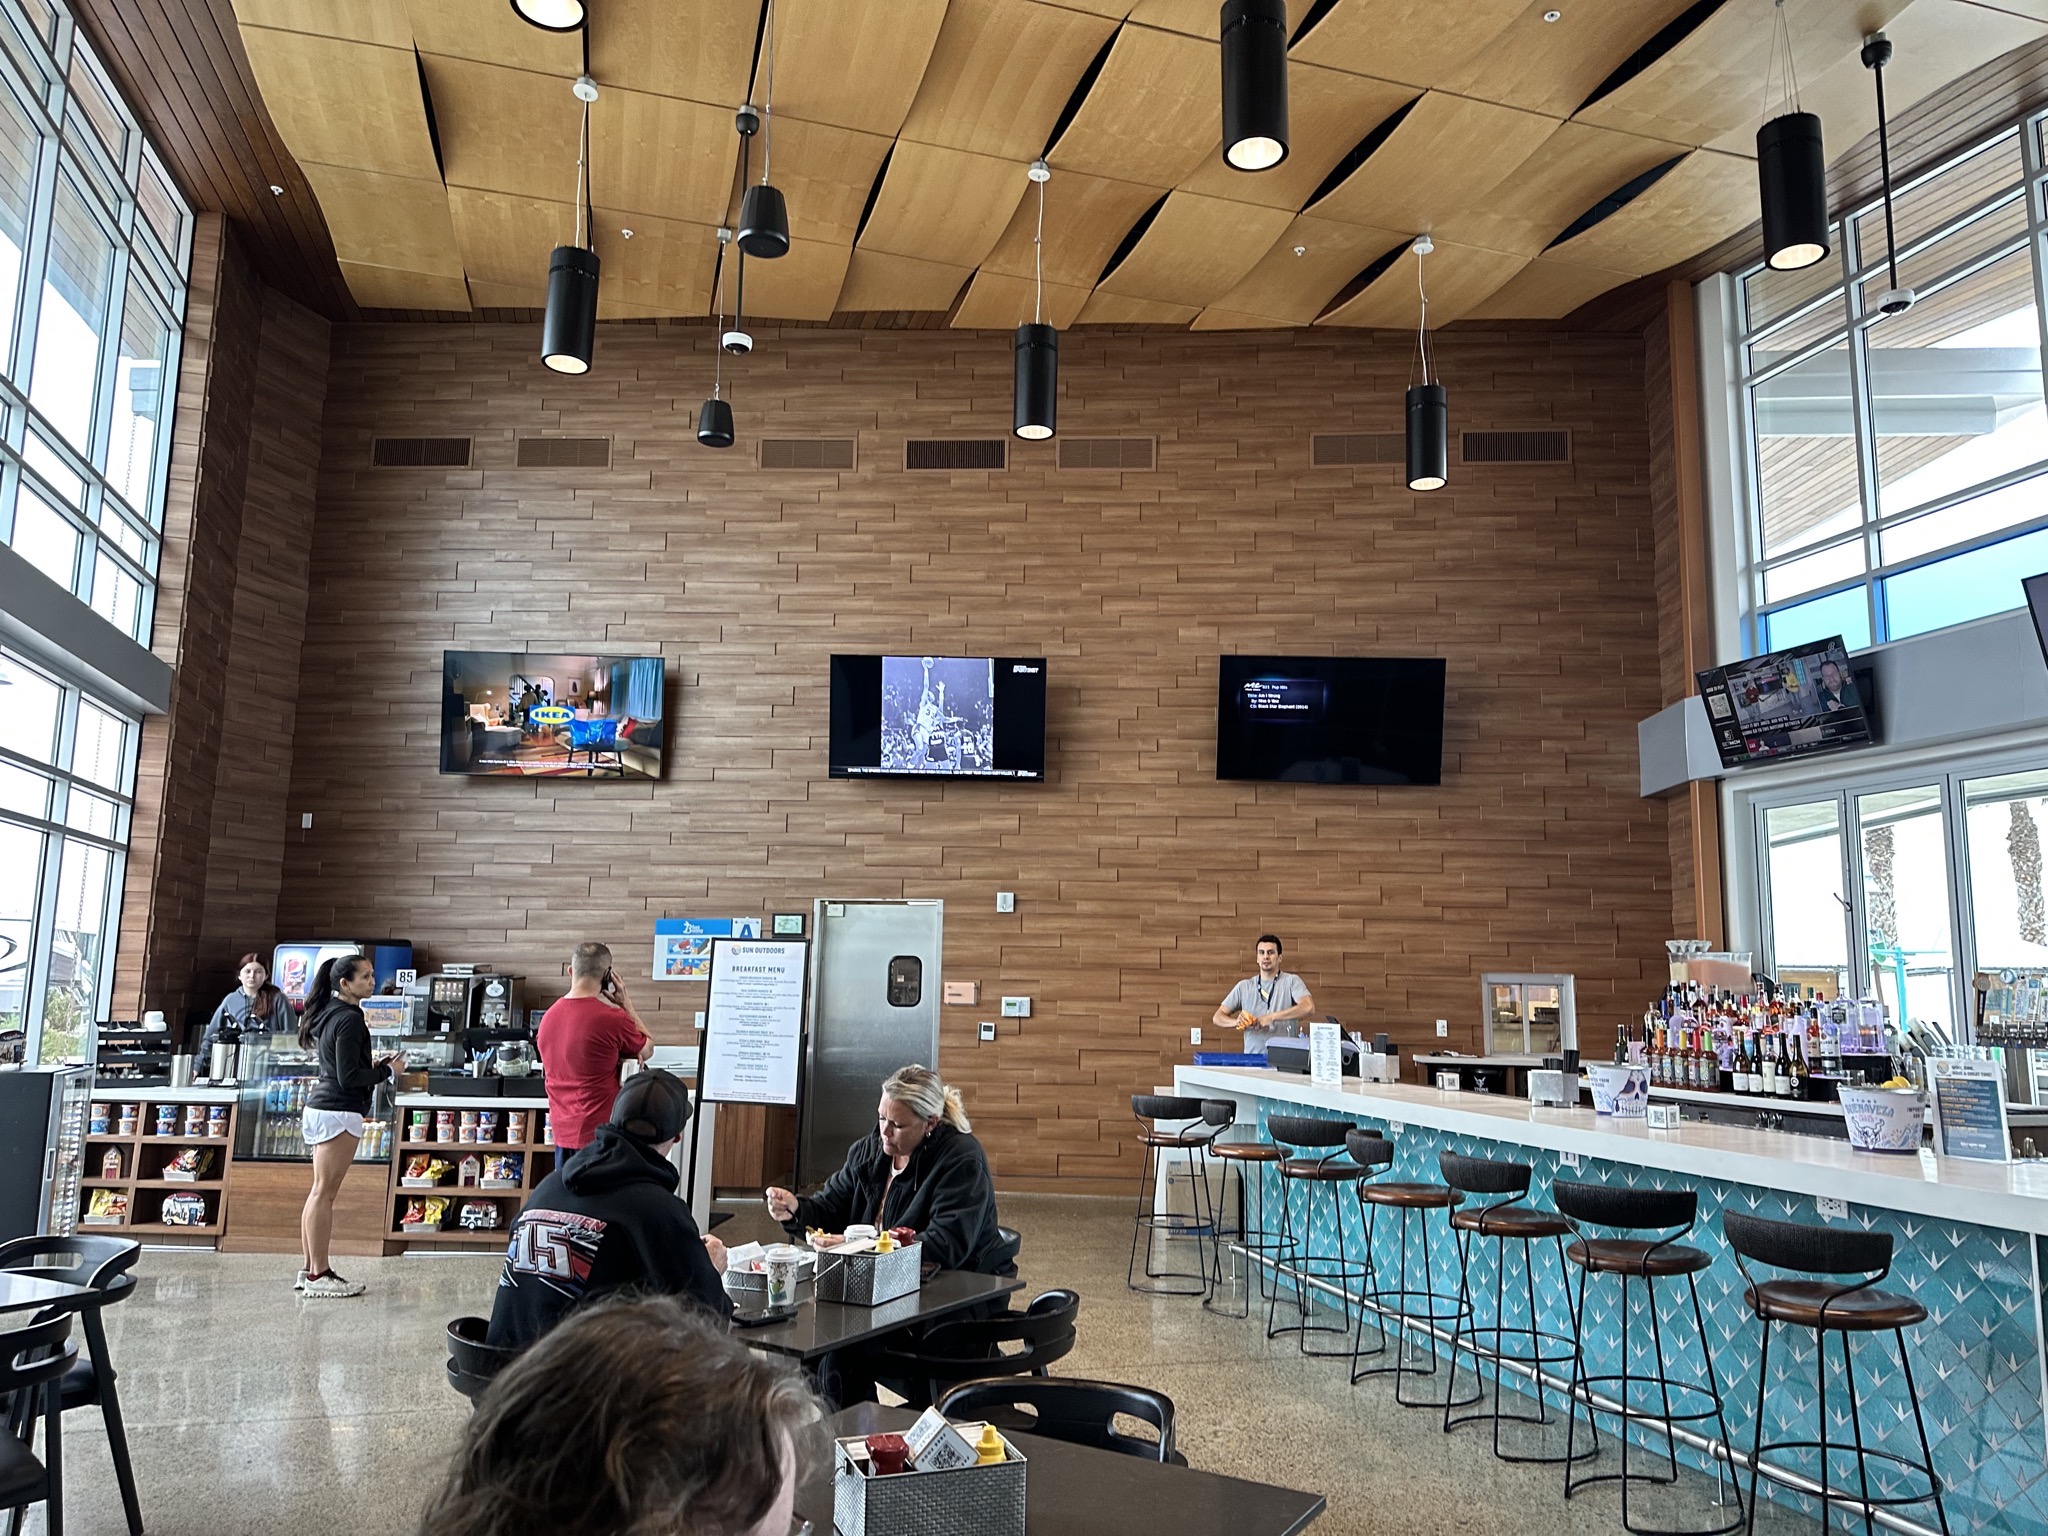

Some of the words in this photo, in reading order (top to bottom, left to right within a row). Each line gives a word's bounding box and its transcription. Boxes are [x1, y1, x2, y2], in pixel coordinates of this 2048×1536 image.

[534, 711, 572, 719] IKEA
[739, 924, 754, 938] A
[400, 972, 413, 982] 85
[513, 1222, 574, 1280] 15
